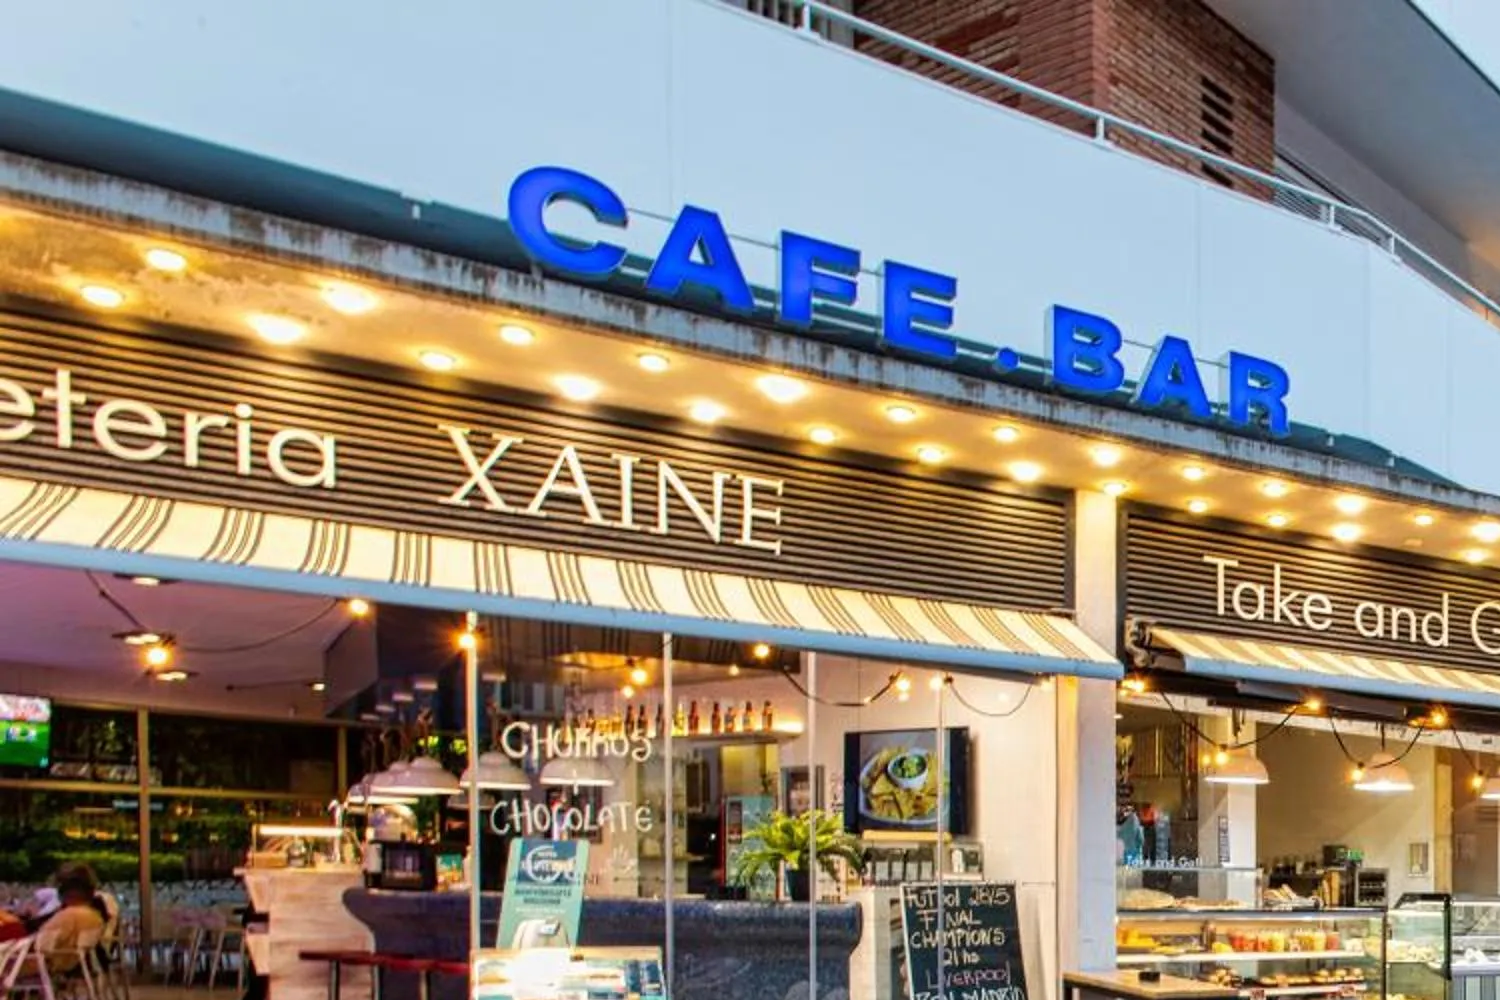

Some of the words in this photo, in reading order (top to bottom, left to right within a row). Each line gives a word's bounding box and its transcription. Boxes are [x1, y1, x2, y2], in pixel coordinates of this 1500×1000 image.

[437, 422, 784, 556] XAINE
[1203, 555, 1333, 631] Take
[1355, 592, 1449, 647] and
[502, 721, 652, 762] CHURROS
[490, 798, 653, 836] CHOCOLATE
[905, 887, 960, 909] FUTol
[916, 908, 982, 930] FNAL
